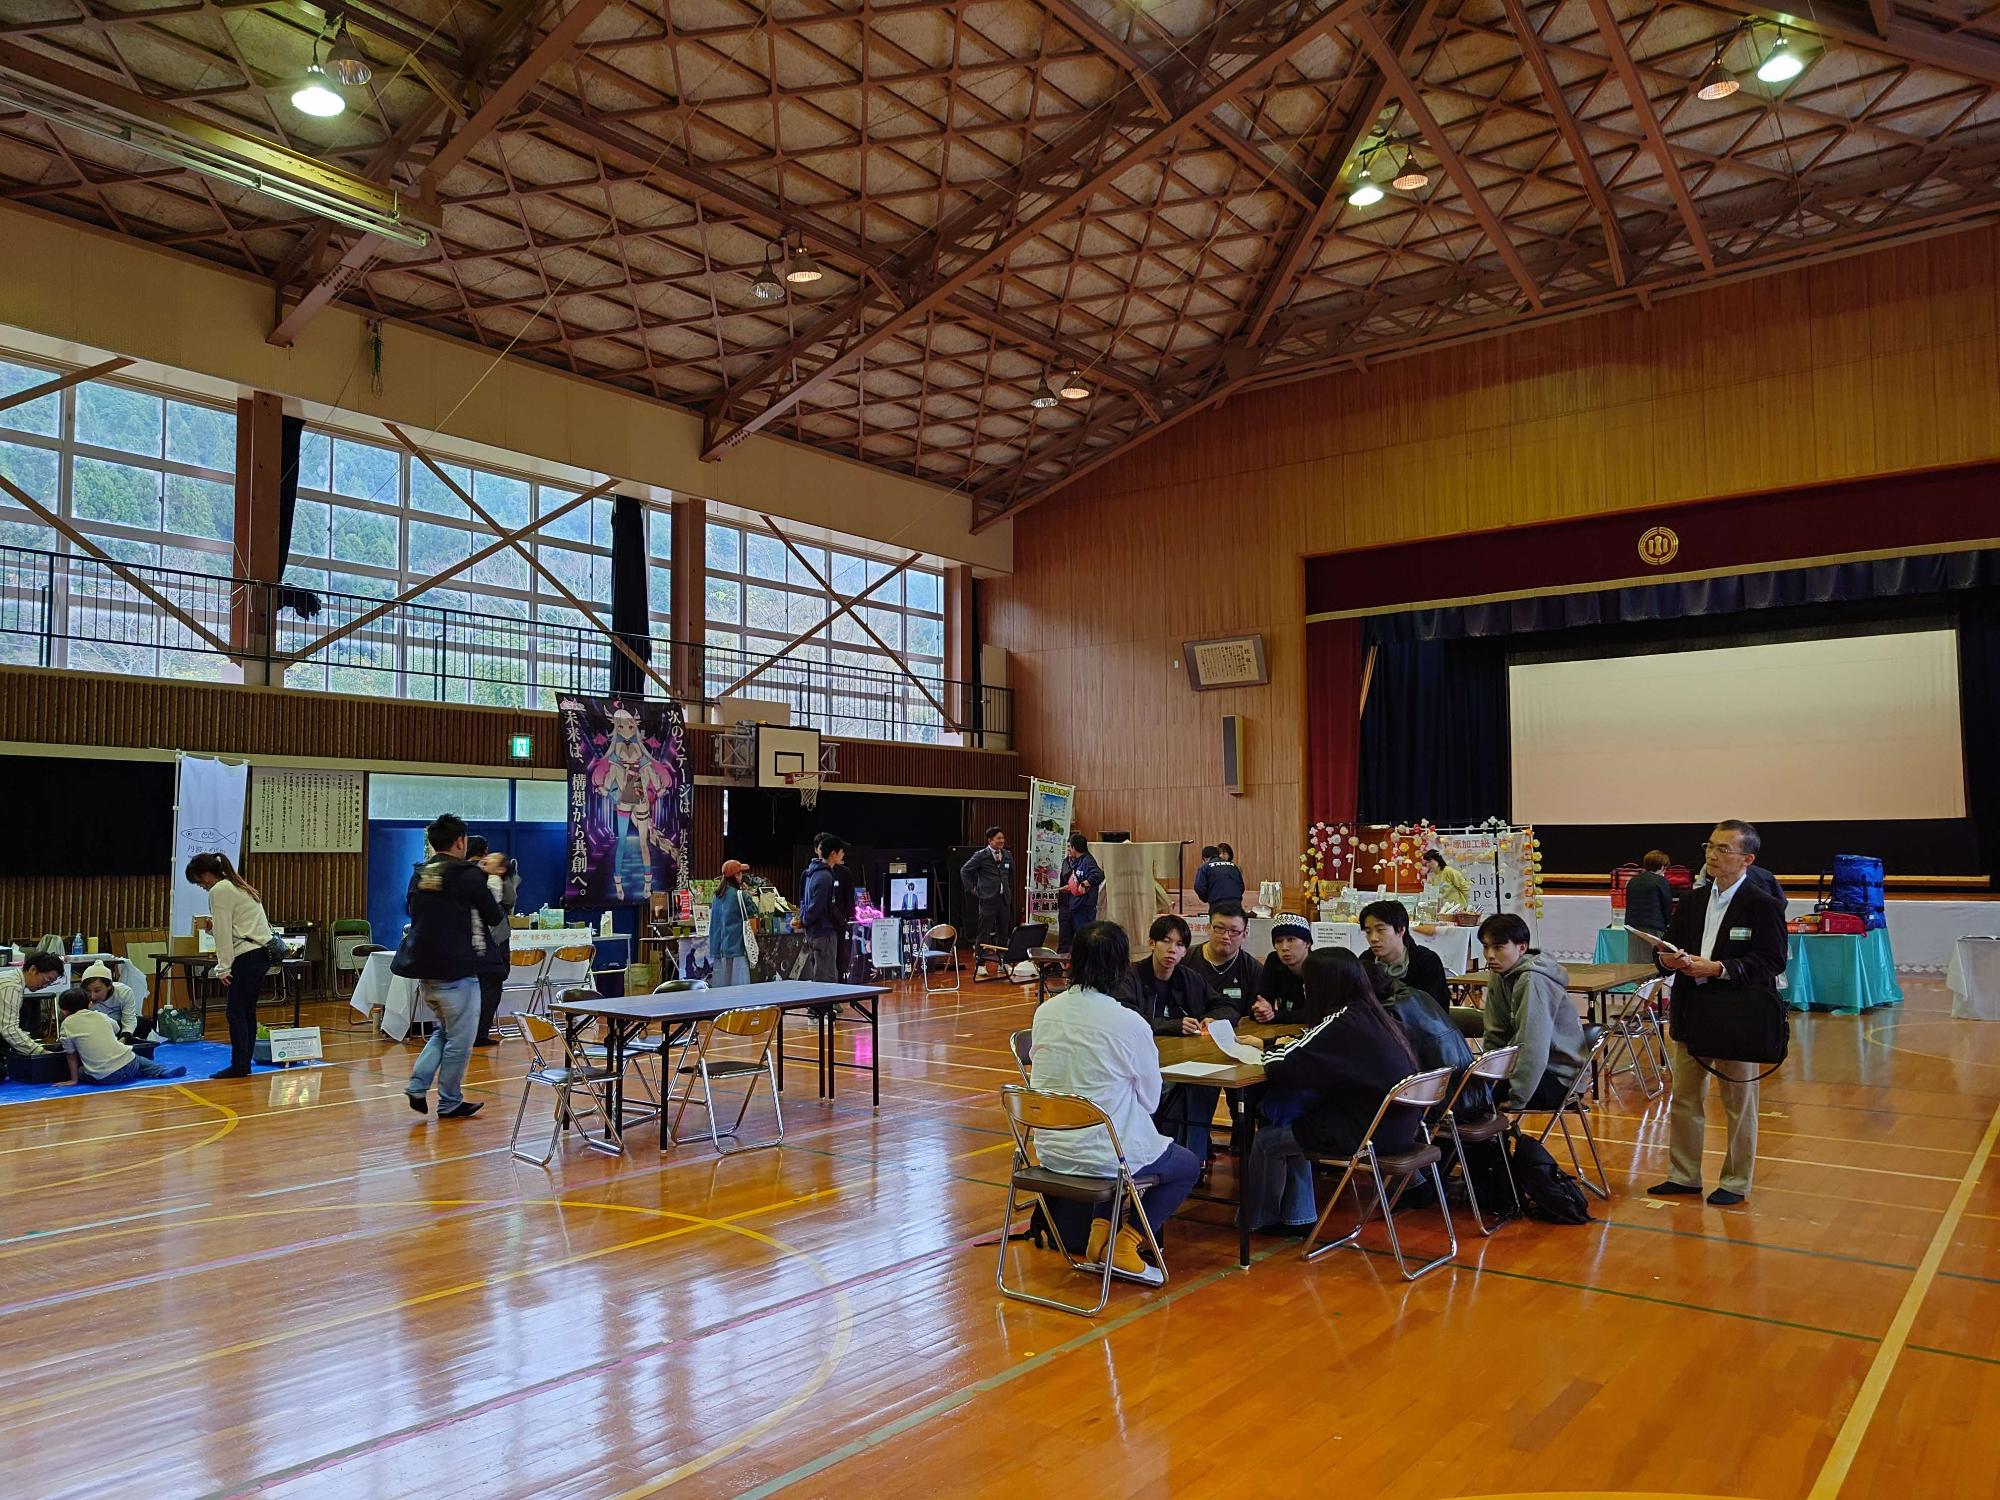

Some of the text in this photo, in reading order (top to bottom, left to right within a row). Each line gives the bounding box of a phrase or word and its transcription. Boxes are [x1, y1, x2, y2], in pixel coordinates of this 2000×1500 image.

[564, 711, 585, 765] 未来は、
[571, 773, 587, 896] 構想から共創へ。
